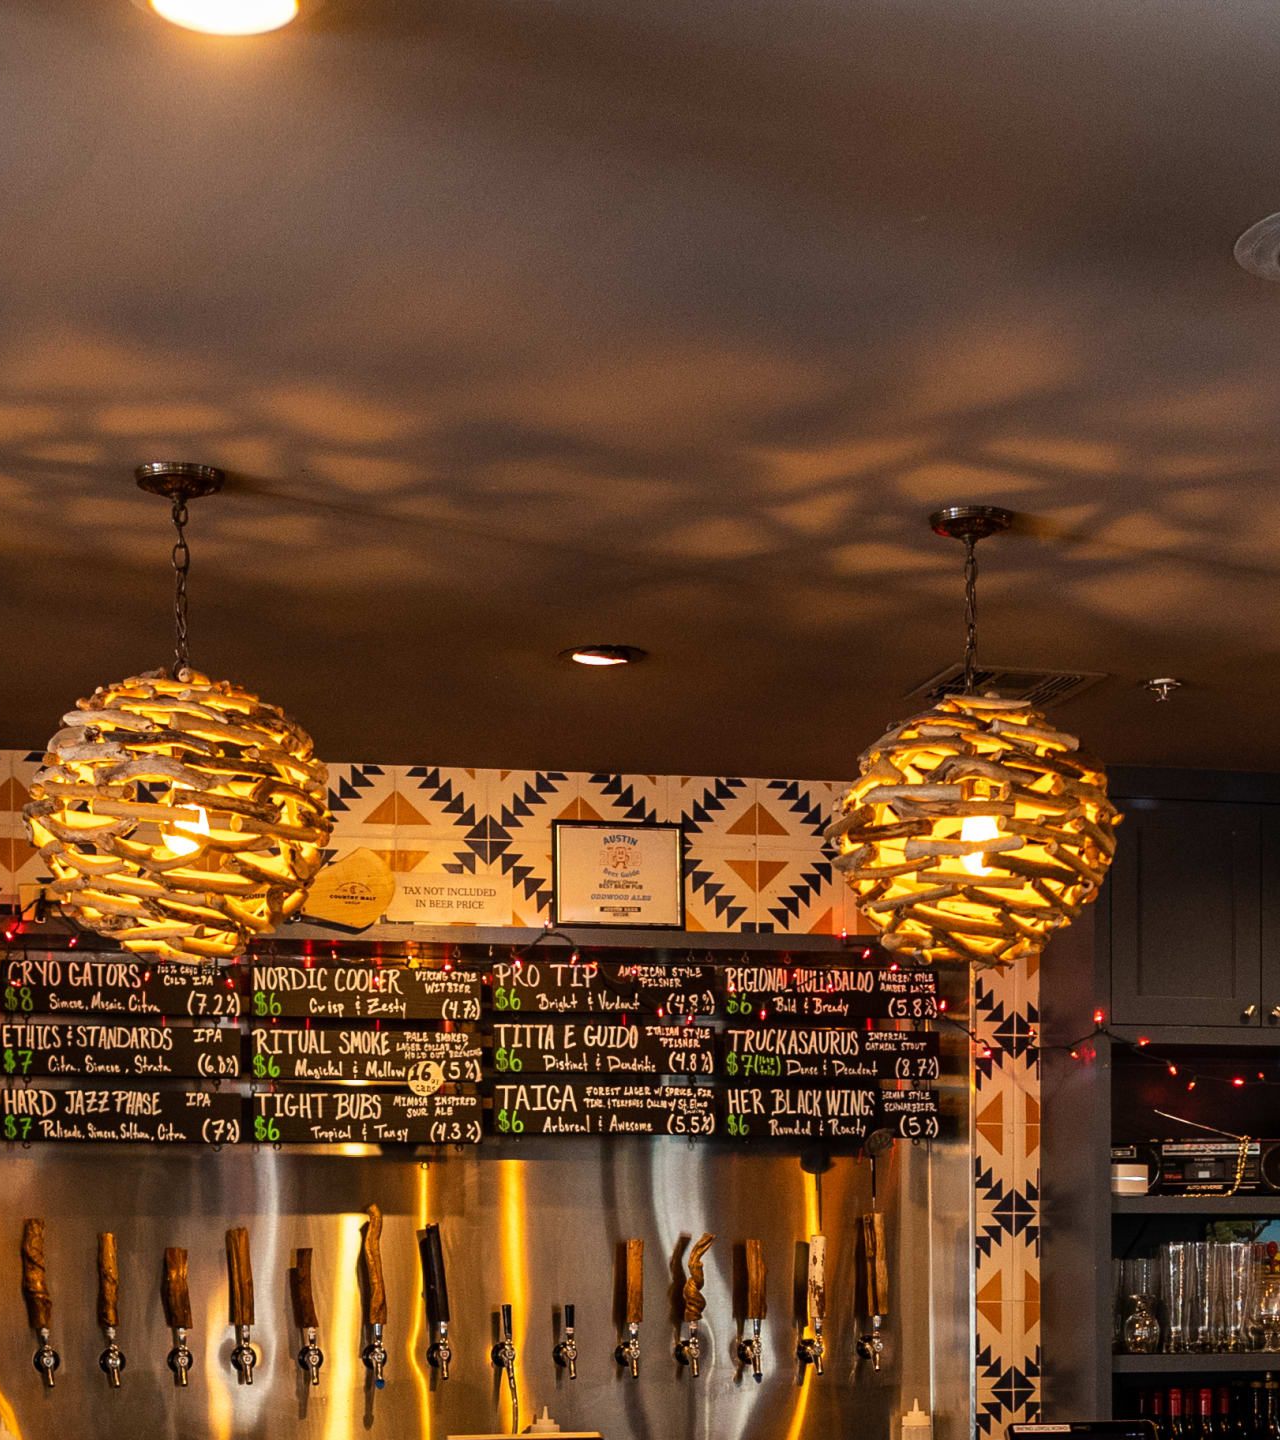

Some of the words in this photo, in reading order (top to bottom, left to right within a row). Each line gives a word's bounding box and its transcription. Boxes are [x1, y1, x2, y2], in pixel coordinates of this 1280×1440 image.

[603, 835, 638, 846] AUSTIN
[403, 887, 420, 895] TAX
[424, 887, 445, 896] NOT
[448, 887, 496, 897] INCLUDED
[429, 900, 453, 908] BEER
[457, 901, 484, 909] PRICE
[8, 961, 60, 986] CRYO
[69, 962, 141, 988] GATORS
[164, 976, 186, 986] COLD
[194, 975, 213, 986] IPA
[254, 968, 328, 991] NORDIC
[335, 969, 403, 995] COOLER
[415, 972, 447, 982] VIKING
[451, 972, 477, 982] STYLE
[493, 963, 540, 987] PRO
[550, 963, 598, 987] TIP
[639, 978, 682, 988] PILSNER
[672, 967, 702, 978] STYLE
[725, 968, 792, 992] REGIONAL
[915, 972, 934, 982] STYLE
[425, 983, 471, 994] WITBIER
[880, 982, 907, 992] AMBER
[5, 987, 33, 1011] $8
[129, 991, 160, 1013] Citra
[187, 991, 241, 1016] (7.2%)
[254, 992, 282, 1016] $6
[309, 1000, 344, 1017] Crisp
[367, 999, 407, 1019] Zesty
[442, 998, 481, 1020] (4.7%)
[496, 988, 520, 1010] $6
[536, 993, 577, 1012] Bright
[598, 991, 640, 1011] Verdant
[727, 994, 752, 1014] $6
[773, 998, 796, 1013] Bold
[813, 998, 849, 1017] Bready
[3, 1025, 61, 1050] ETHICS
[77, 1026, 172, 1050] STANDARDS
[194, 1029, 222, 1042] IPA
[252, 1029, 331, 1054] RITUAL
[339, 1032, 390, 1055] SMOKE
[404, 1032, 429, 1042] PALE
[435, 1033, 468, 1042] SMOKED
[494, 1024, 555, 1049] TITTA
[565, 1025, 576, 1048] E
[584, 1025, 638, 1049] GUIDO
[646, 1026, 679, 1036] ITALIAN
[683, 1028, 710, 1038] STYLE
[659, 1037, 700, 1048] PILSNER
[728, 1030, 858, 1055] TRUCKASAURUS
[396, 1043, 421, 1051] LAGER
[866, 1043, 896, 1051] OATMEAL
[4, 1050, 32, 1074] $7
[135, 1055, 170, 1072] Strata
[253, 1054, 280, 1077] $6
[366, 1060, 406, 1077] Mellow
[496, 1048, 522, 1072] $6
[543, 1053, 588, 1072] Distinct
[786, 1060, 818, 1075] Dense
[833, 1060, 878, 1076] Decadent
[895, 1057, 939, 1078] (8.7%)
[411, 1063, 431, 1081] 16
[186, 1093, 211, 1107] IPA
[393, 1096, 427, 1107] MIMOSA
[435, 1097, 476, 1106] INSPIRED
[496, 1085, 577, 1112] TAIGA
[586, 1087, 621, 1096] FOREST
[624, 1087, 651, 1095] LAGER
[728, 1089, 765, 1114] HER
[771, 1090, 822, 1116] BLACK
[826, 1090, 875, 1116] WINGS
[909, 1091, 931, 1100] STYLE
[4, 1090, 56, 1116] HARD
[65, 1091, 110, 1115] JAZZ
[112, 1091, 162, 1116] PHASE
[254, 1093, 328, 1119] TIGHT
[333, 1094, 381, 1120] BUBS
[407, 1108, 428, 1118] SOUR
[435, 1108, 453, 1116] ALE
[5, 1115, 32, 1139] $7
[158, 1123, 186, 1140] Citra
[202, 1118, 240, 1143] (7%)
[255, 1116, 280, 1141] $6
[310, 1126, 351, 1142] Tropical
[374, 1124, 408, 1142] Tangy
[499, 1110, 524, 1133] $6
[543, 1115, 590, 1133] Arboreal
[610, 1115, 652, 1131] Awesome
[667, 1114, 715, 1134] (5.5%)
[728, 1114, 749, 1136] $6
[769, 1119, 811, 1136] Rounded
[828, 1118, 866, 1137] Roasty
